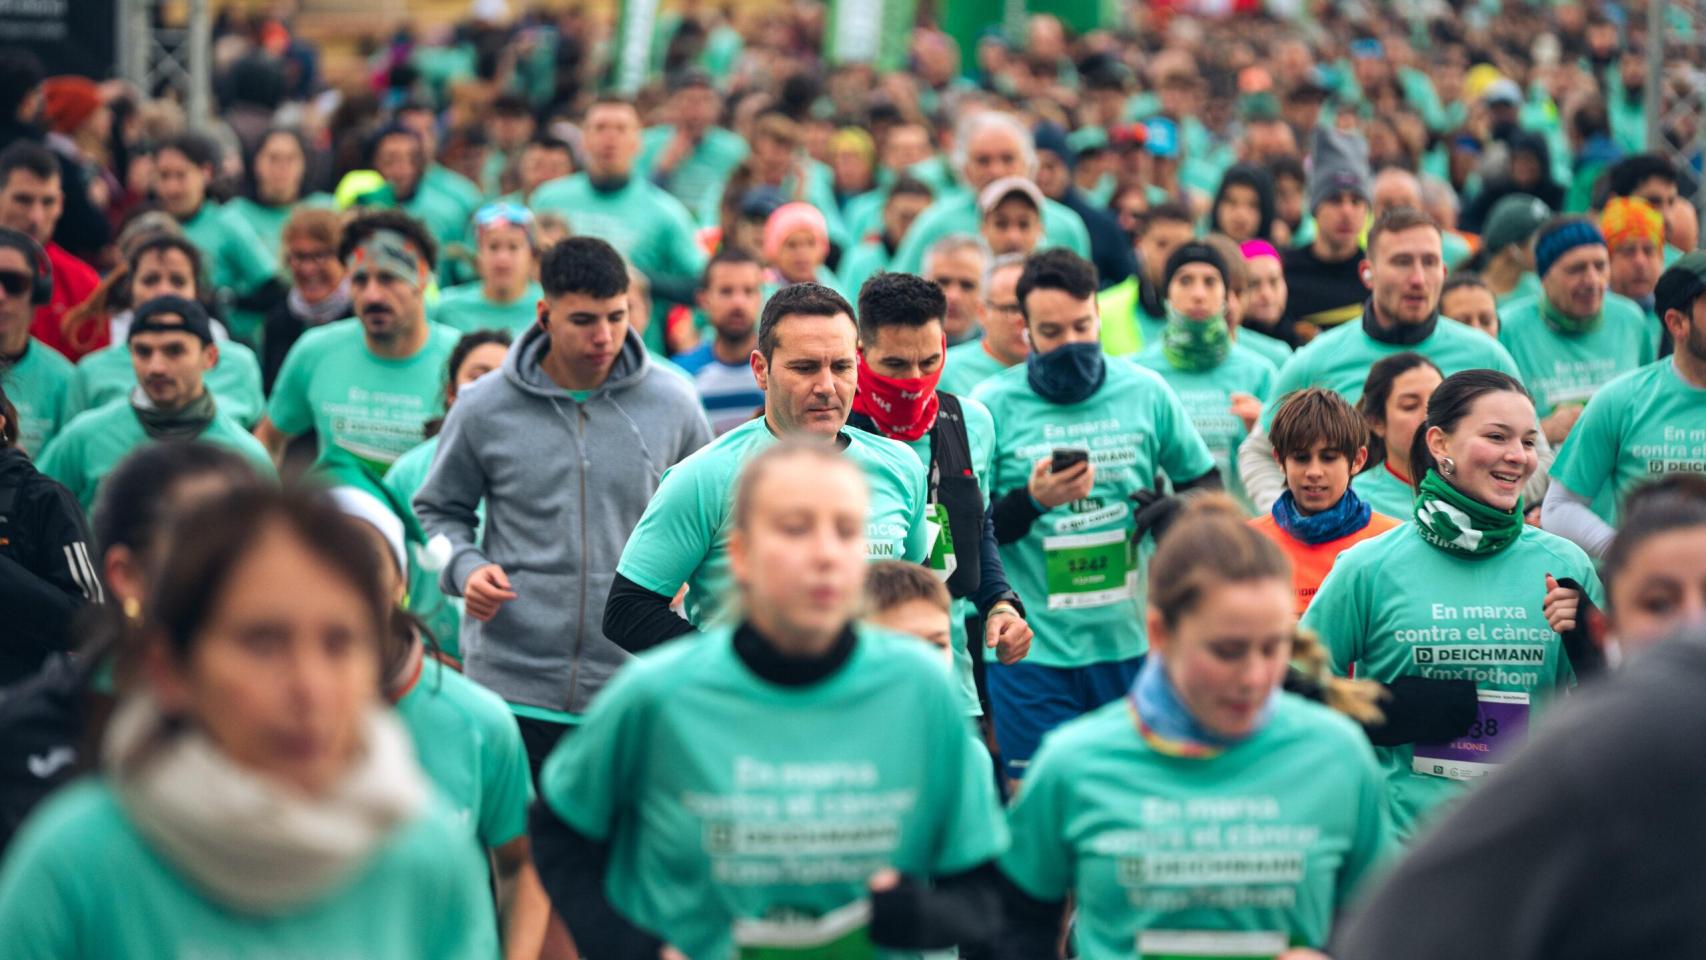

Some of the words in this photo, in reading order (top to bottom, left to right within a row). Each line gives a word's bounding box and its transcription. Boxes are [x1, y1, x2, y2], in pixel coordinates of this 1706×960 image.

[1664, 425, 1685, 441] En
[1632, 442, 1687, 458] contra
[1432, 603, 1457, 620] En
[1463, 605, 1527, 620] marxa
[1394, 625, 1461, 642] contra
[1466, 623, 1487, 641] el
[1492, 624, 1557, 642] càncer
[1438, 649, 1543, 661] DEICHMANN
[1421, 666, 1538, 685] KmxTothom
[1457, 742, 1489, 752] LIONEL
